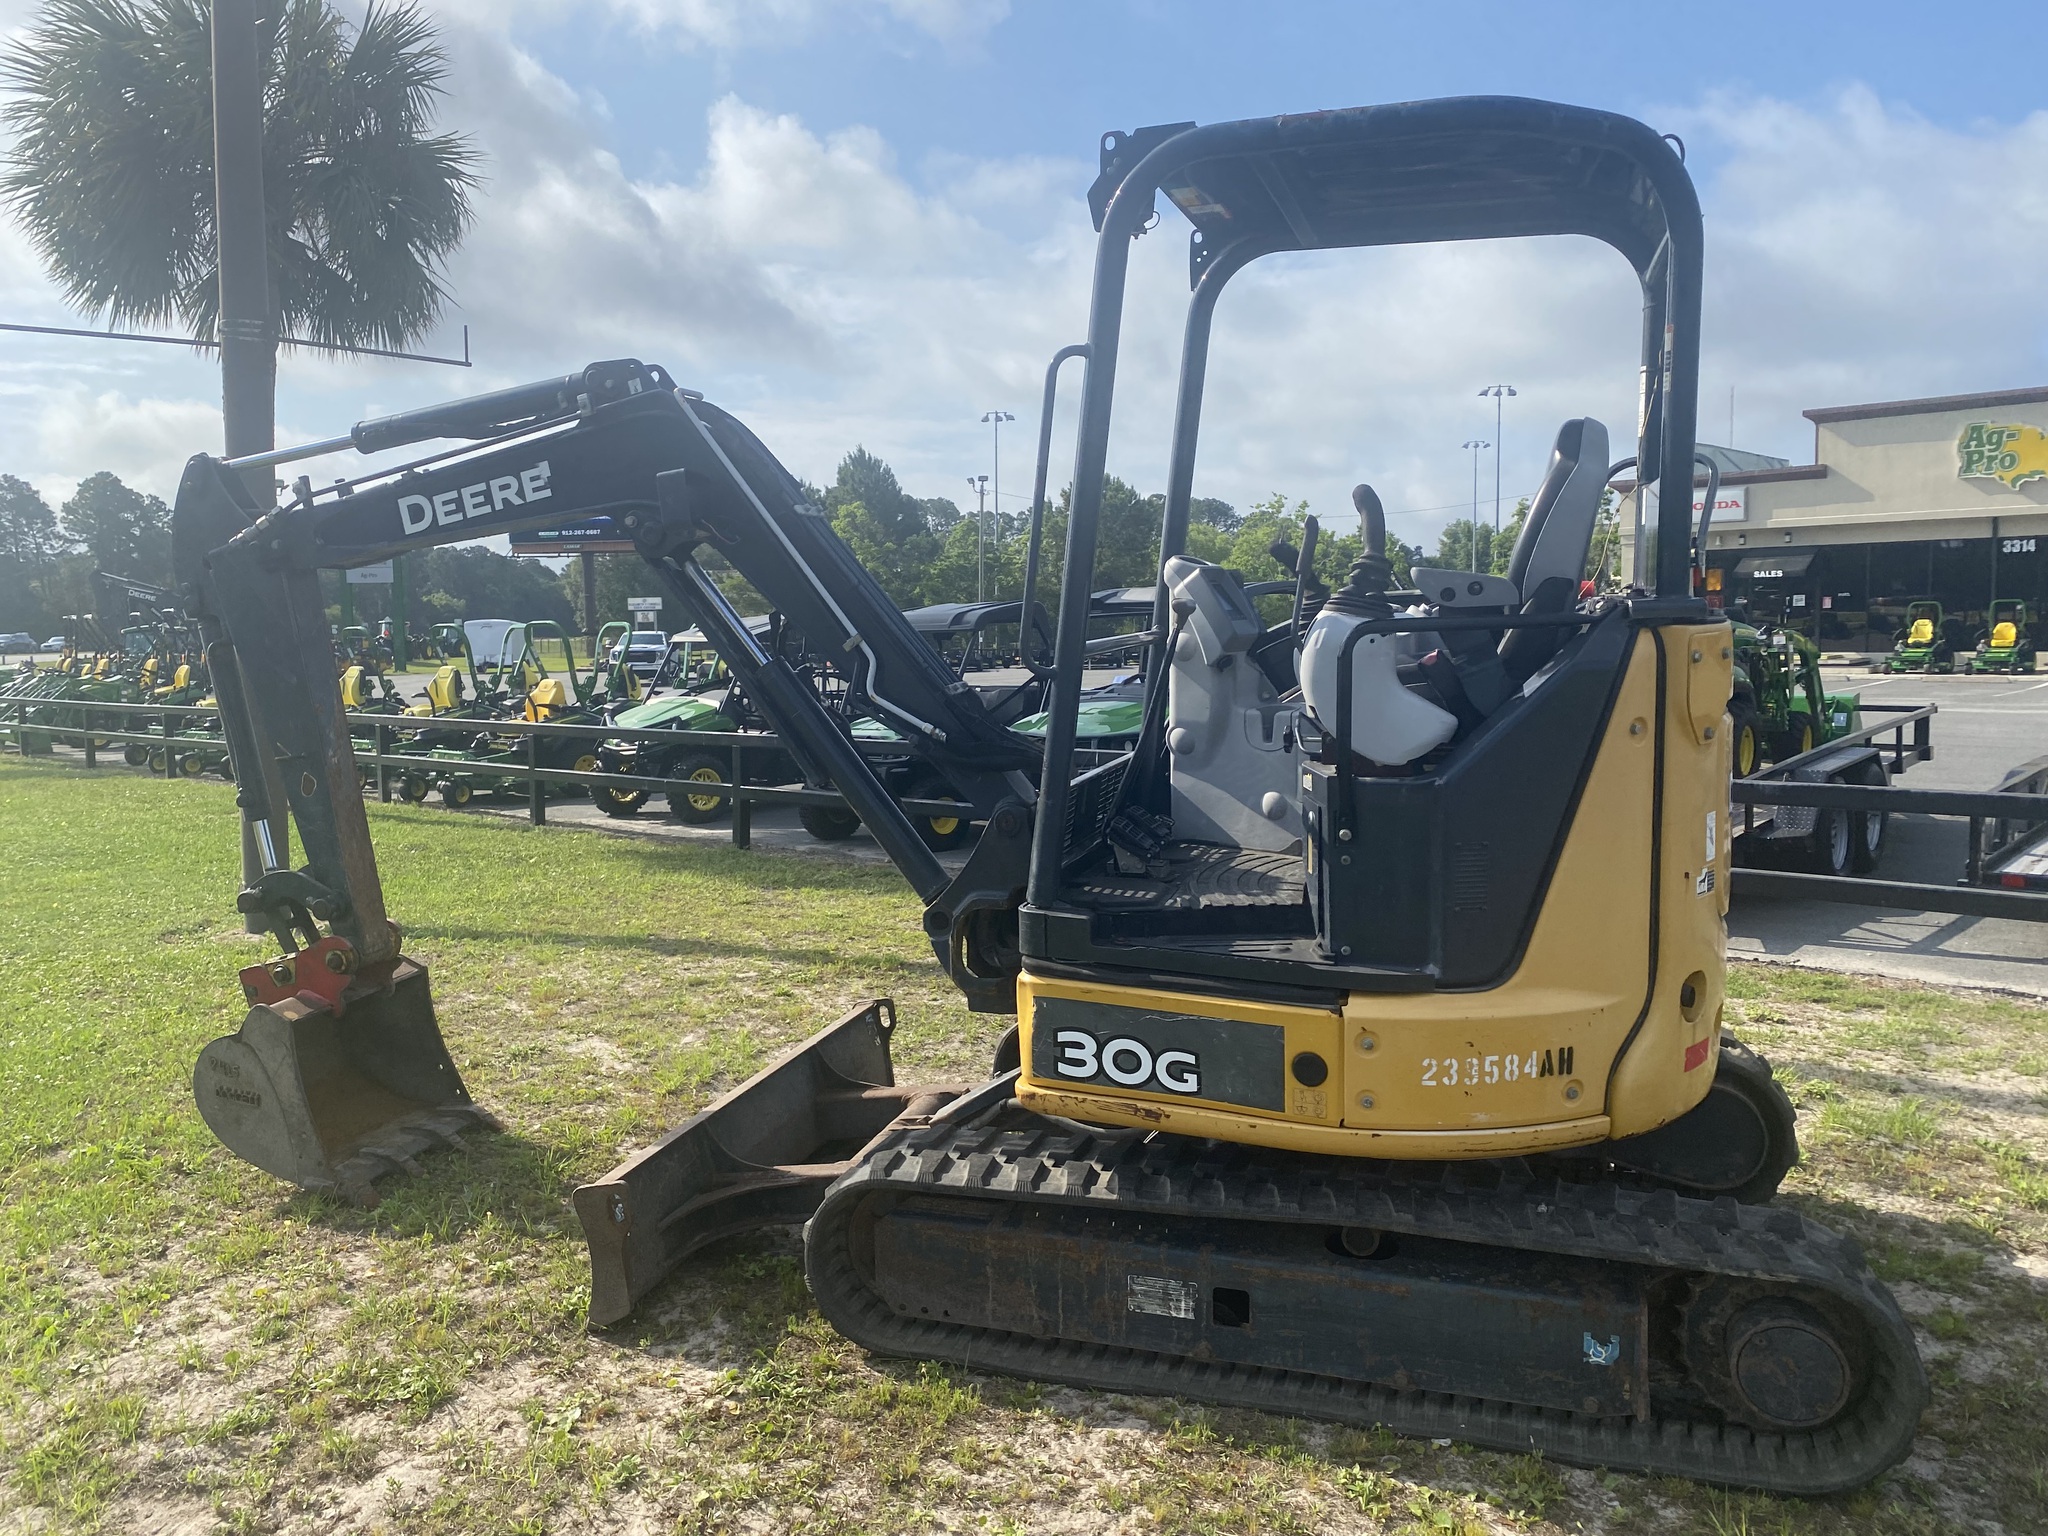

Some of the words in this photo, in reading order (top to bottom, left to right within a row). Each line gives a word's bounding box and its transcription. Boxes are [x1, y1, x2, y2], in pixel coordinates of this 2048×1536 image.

[1961, 422, 2020, 453] Ag-
[1960, 451, 2018, 475] Pro
[398, 460, 552, 535] DEERE
[1692, 500, 1743, 511] ODA
[2002, 538, 2036, 553] 3314
[1753, 569, 1784, 578] SALES
[128, 589, 157, 602] DEERE
[1055, 1029, 1200, 1094] 30G
